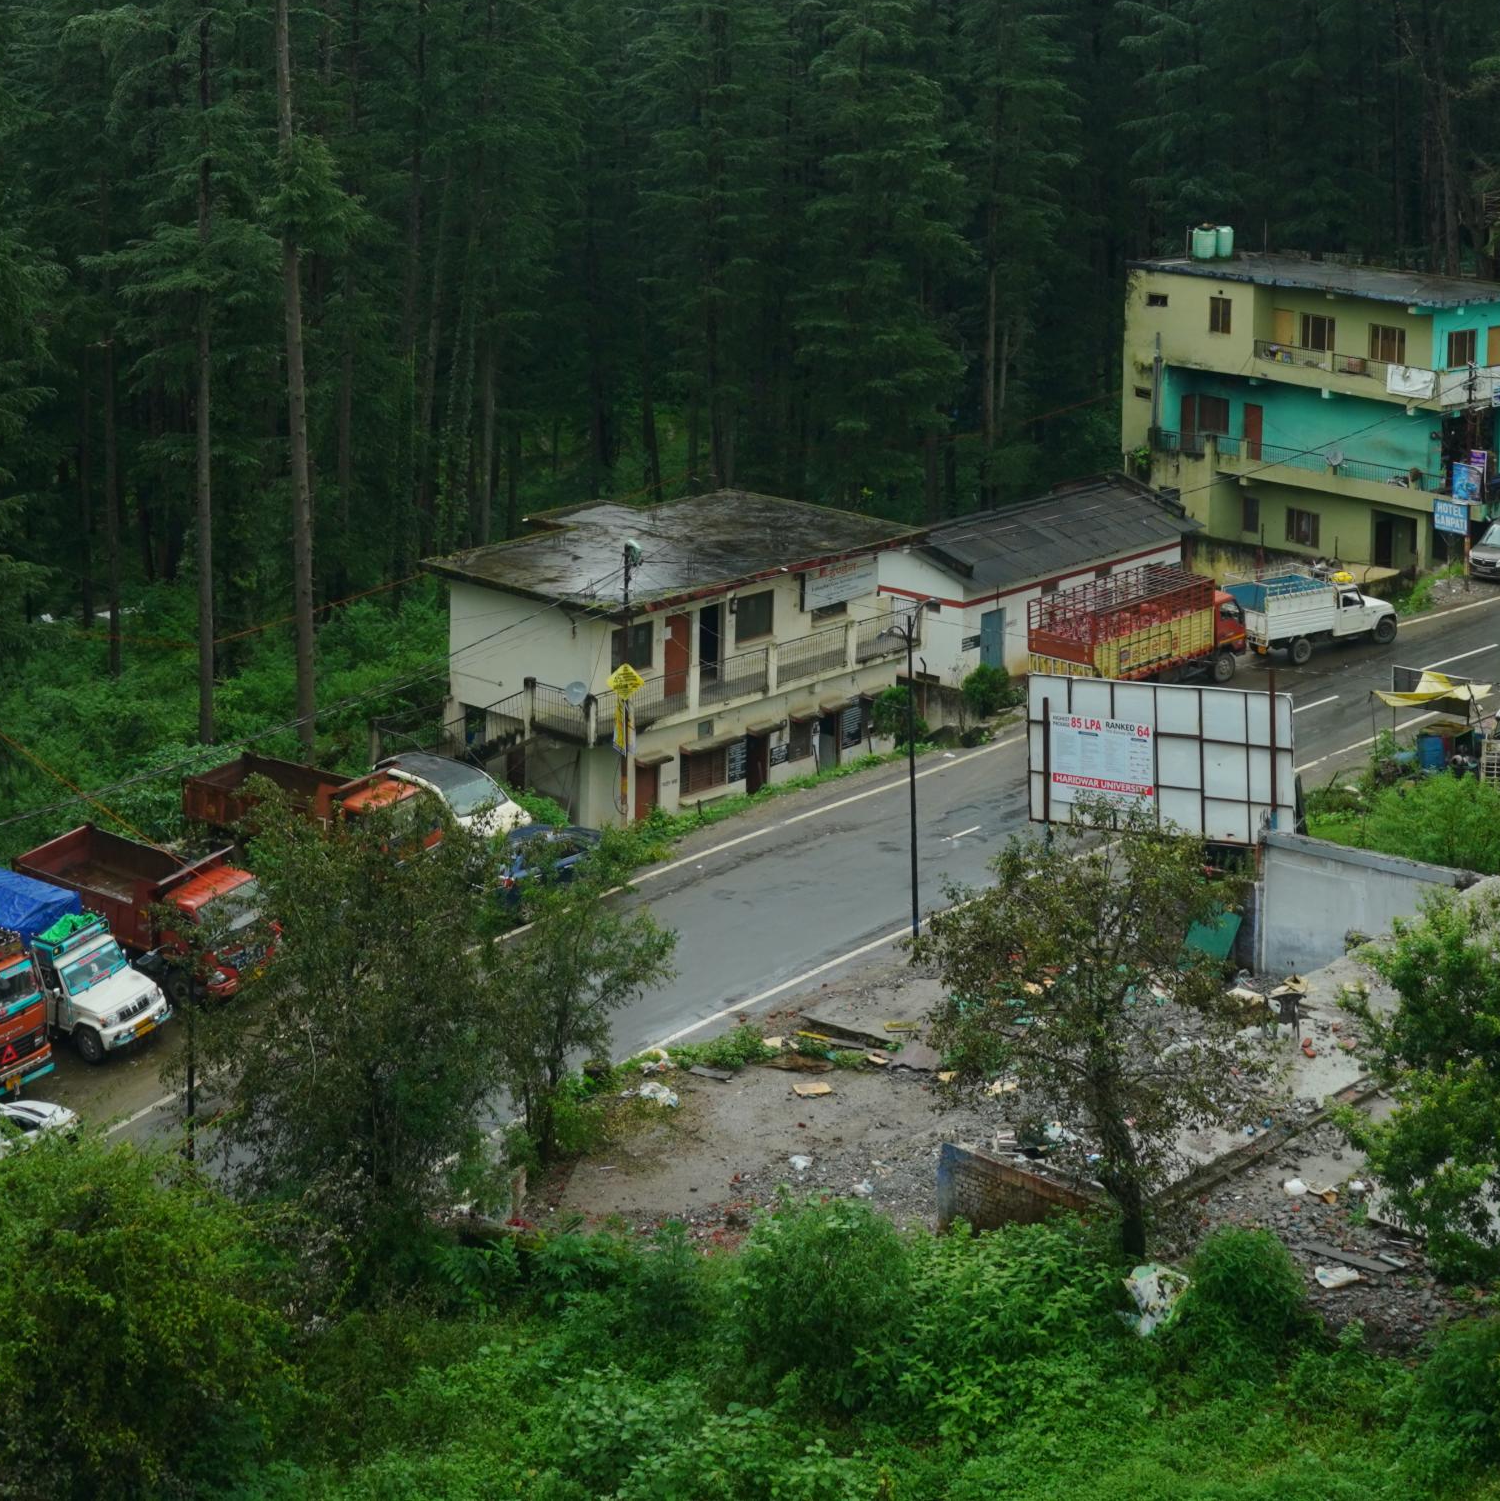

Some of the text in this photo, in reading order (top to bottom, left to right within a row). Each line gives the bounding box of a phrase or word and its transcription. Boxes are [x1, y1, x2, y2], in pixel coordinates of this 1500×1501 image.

[1436, 501, 1464, 517] HOTEL
[1434, 514, 1468, 532] GANPATI
[1071, 717, 1102, 731] 85 LPA
[1105, 721, 1136, 732] RANKED
[1137, 725, 1150, 738] 64
[1055, 774, 1100, 787] HARIDWAR
[1101, 781, 1149, 794] UNIVERSITY
